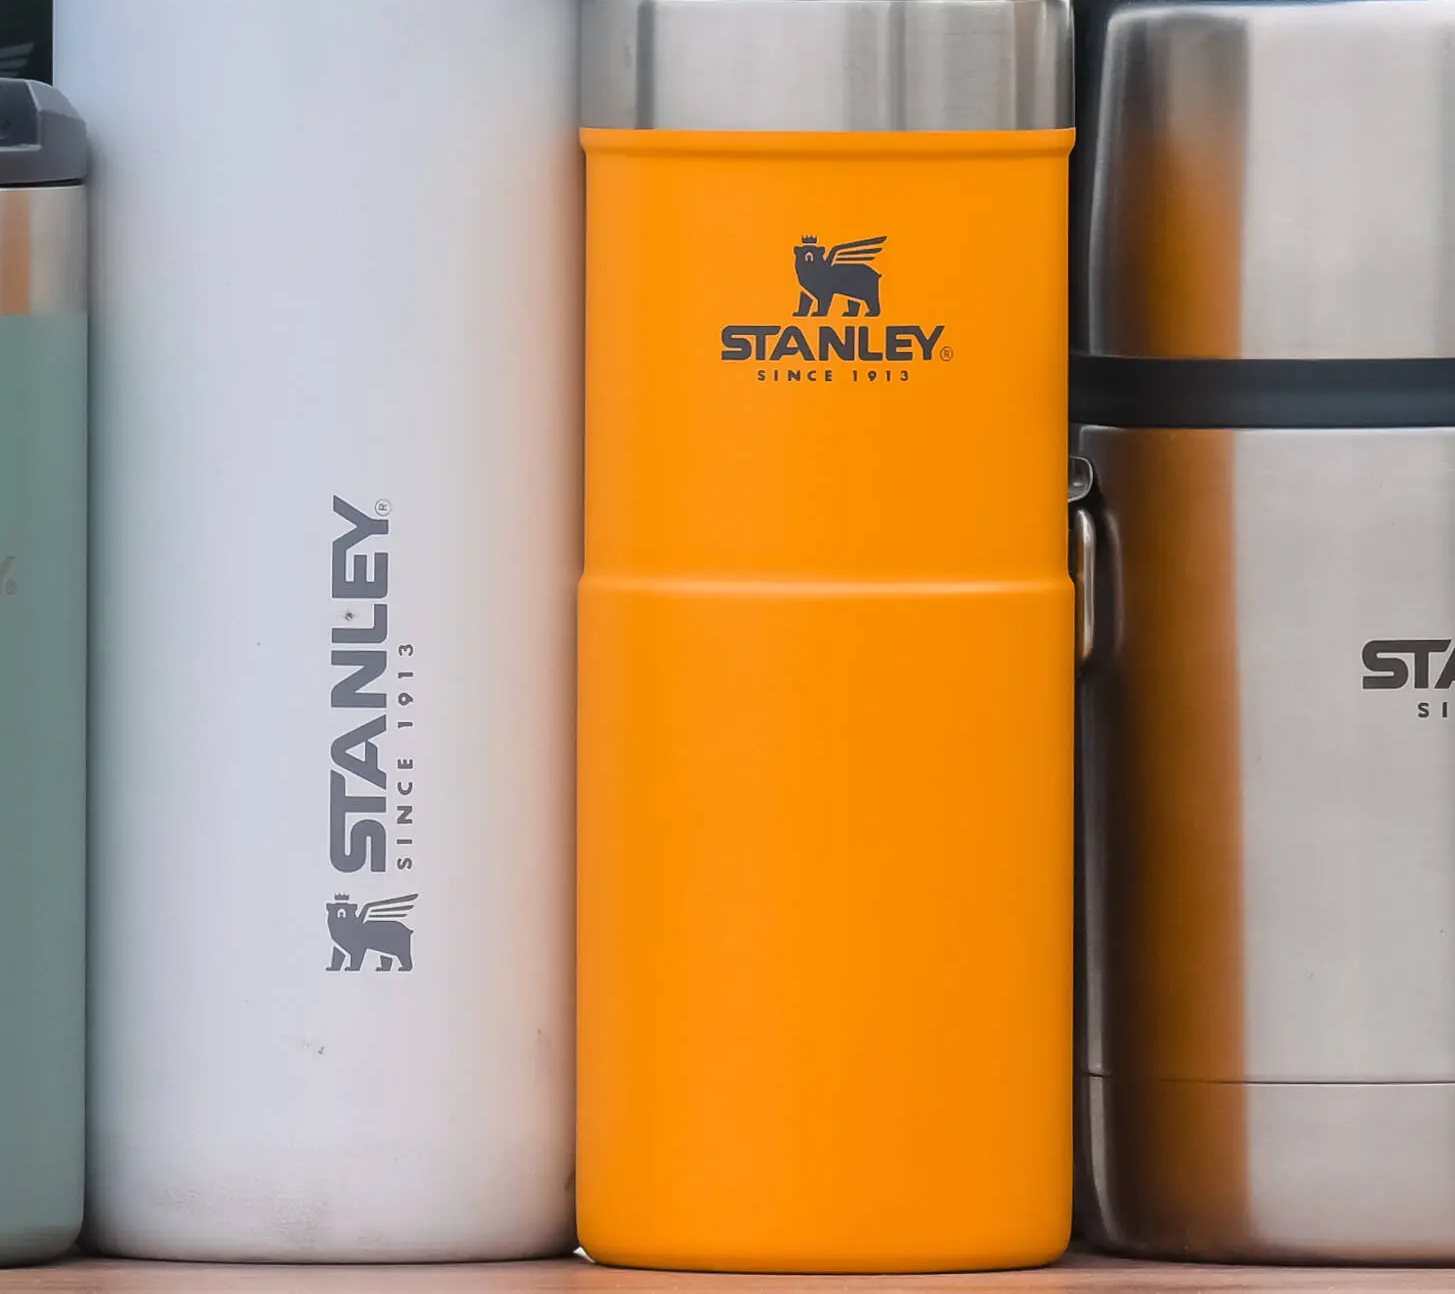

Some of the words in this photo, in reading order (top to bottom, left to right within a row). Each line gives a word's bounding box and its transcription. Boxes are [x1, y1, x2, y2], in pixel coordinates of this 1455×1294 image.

[721, 324, 946, 362] STANLEY
[757, 368, 833, 382] SINCE
[851, 368, 910, 382] 1913
[330, 494, 389, 874] STANLEY
[396, 642, 415, 730] 1913
[396, 758, 415, 871] SINCE
